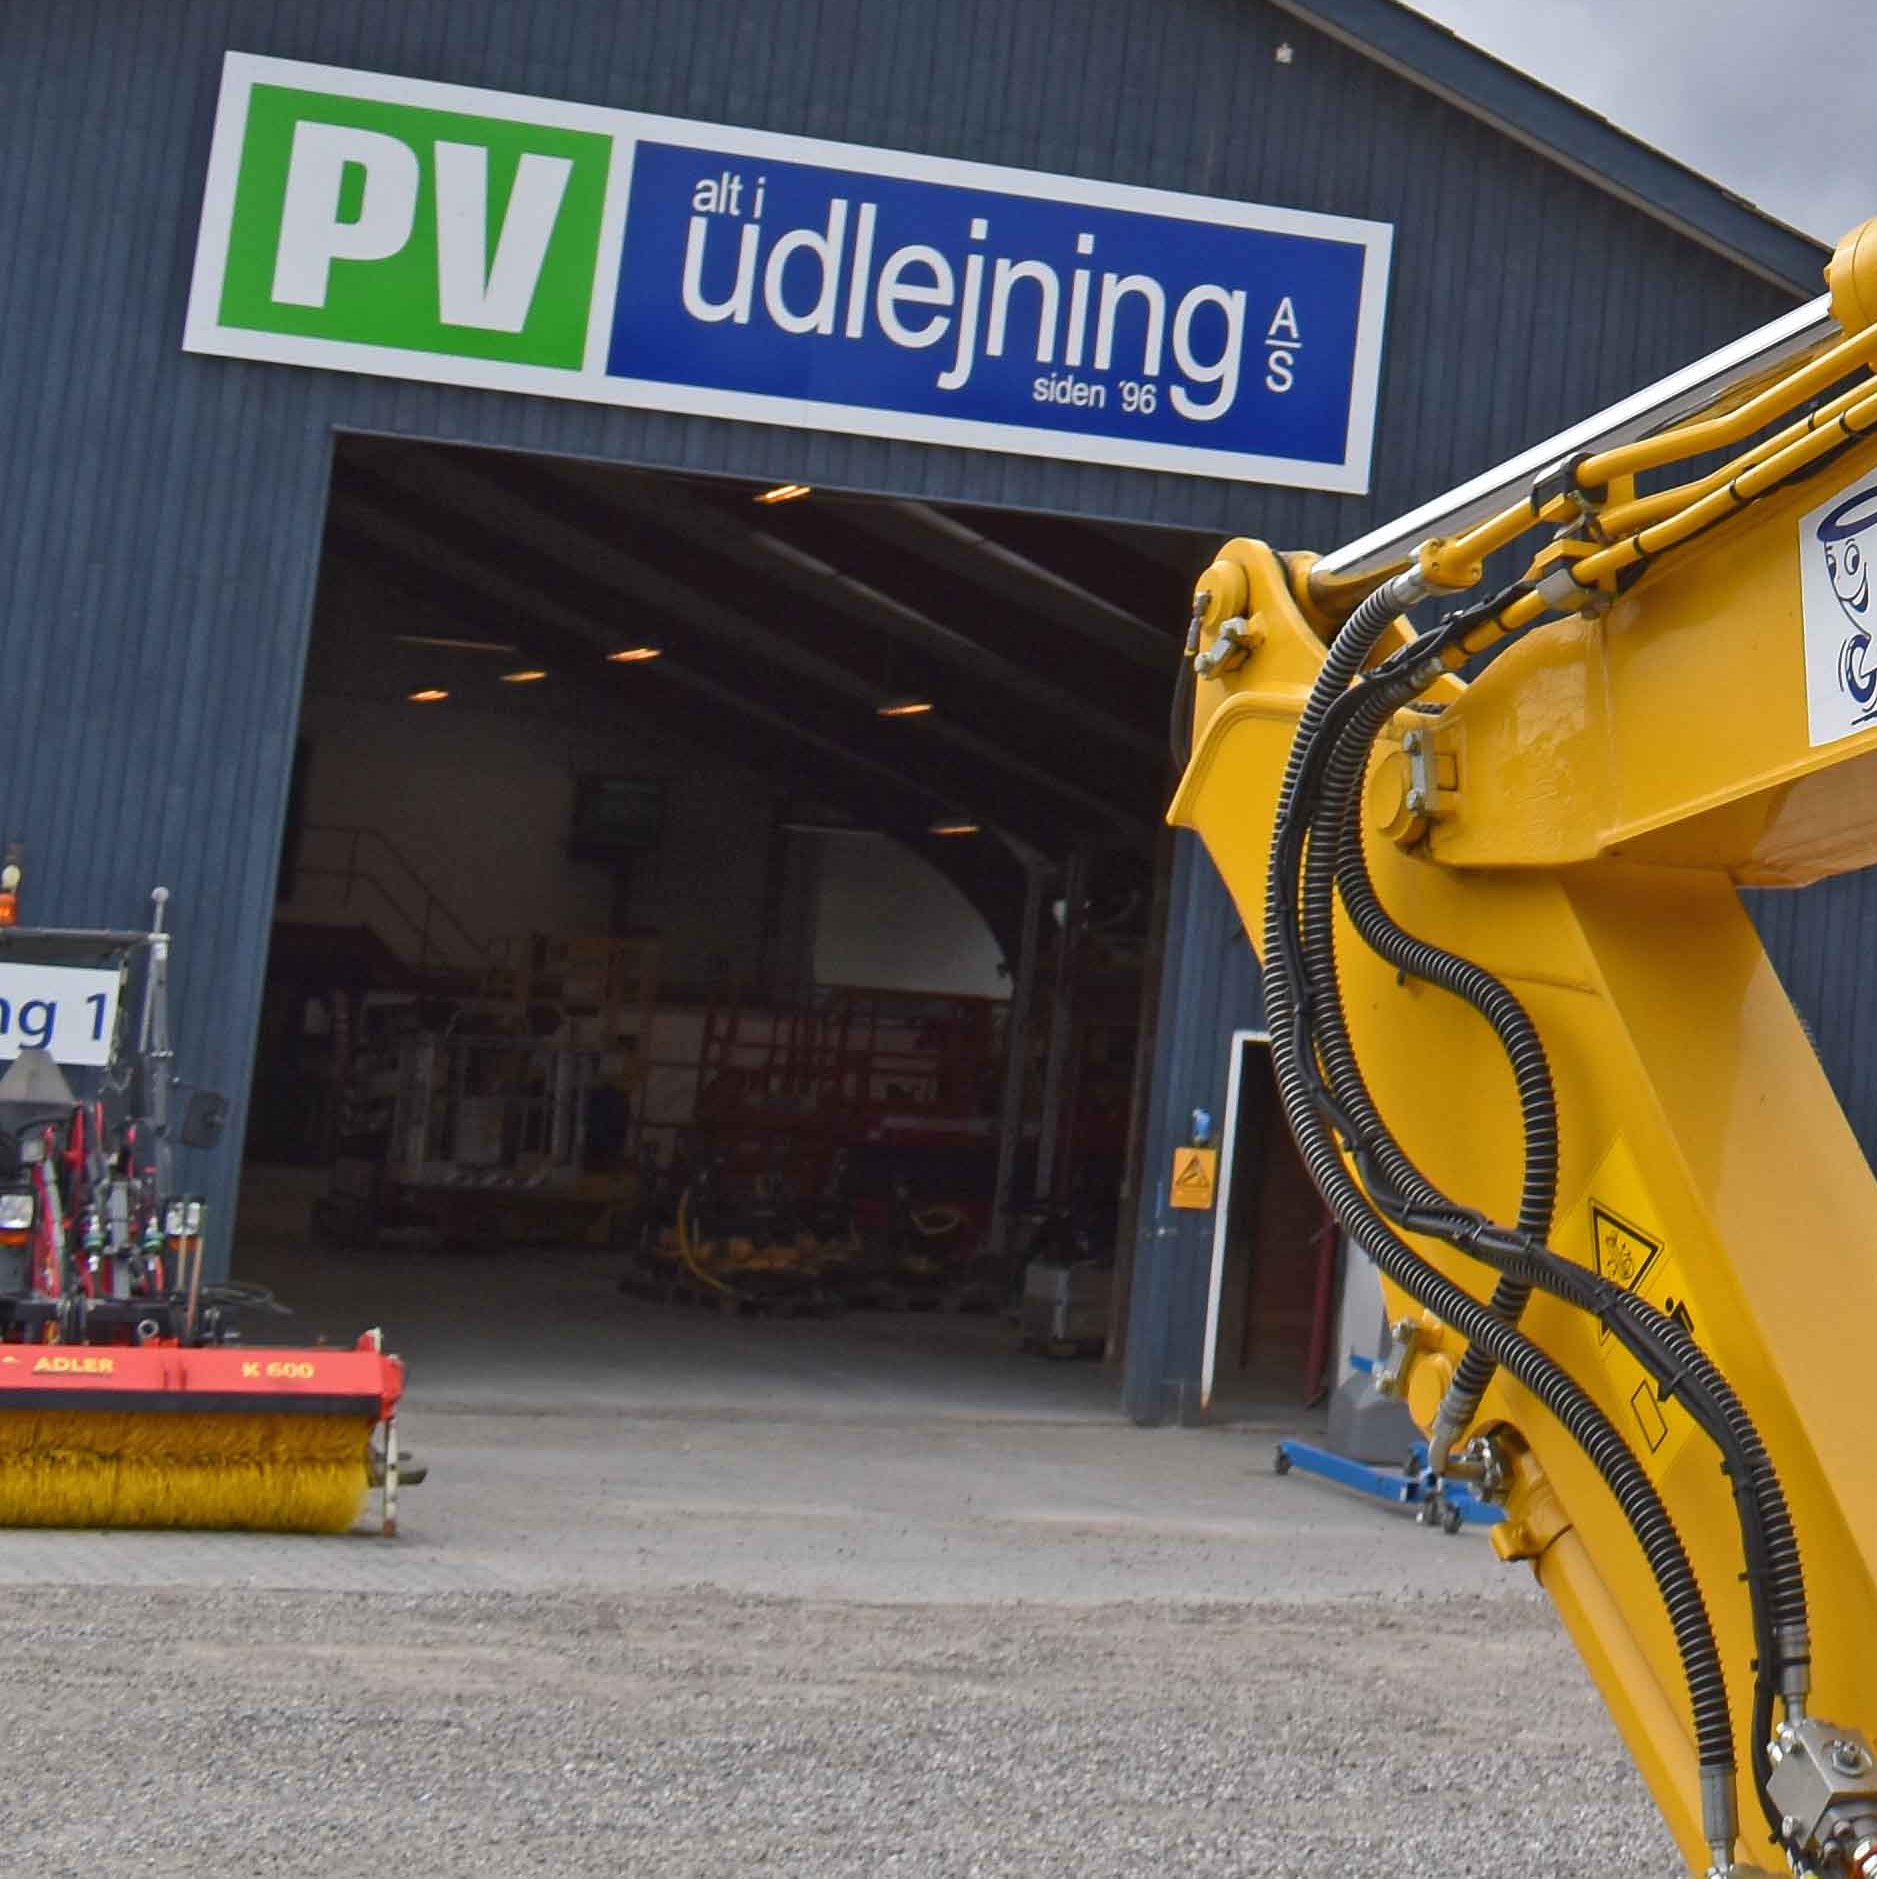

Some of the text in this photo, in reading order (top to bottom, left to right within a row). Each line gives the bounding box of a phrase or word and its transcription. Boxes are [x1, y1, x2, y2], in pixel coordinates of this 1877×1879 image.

[693, 172, 765, 219] alt i
[271, 121, 573, 333] PV
[683, 199, 1247, 420] udlejning
[1034, 374, 1106, 409] siden
[86, 993, 107, 1041] 1
[33, 1356, 114, 1373] ADLER
[242, 1361, 316, 1379] K 600
